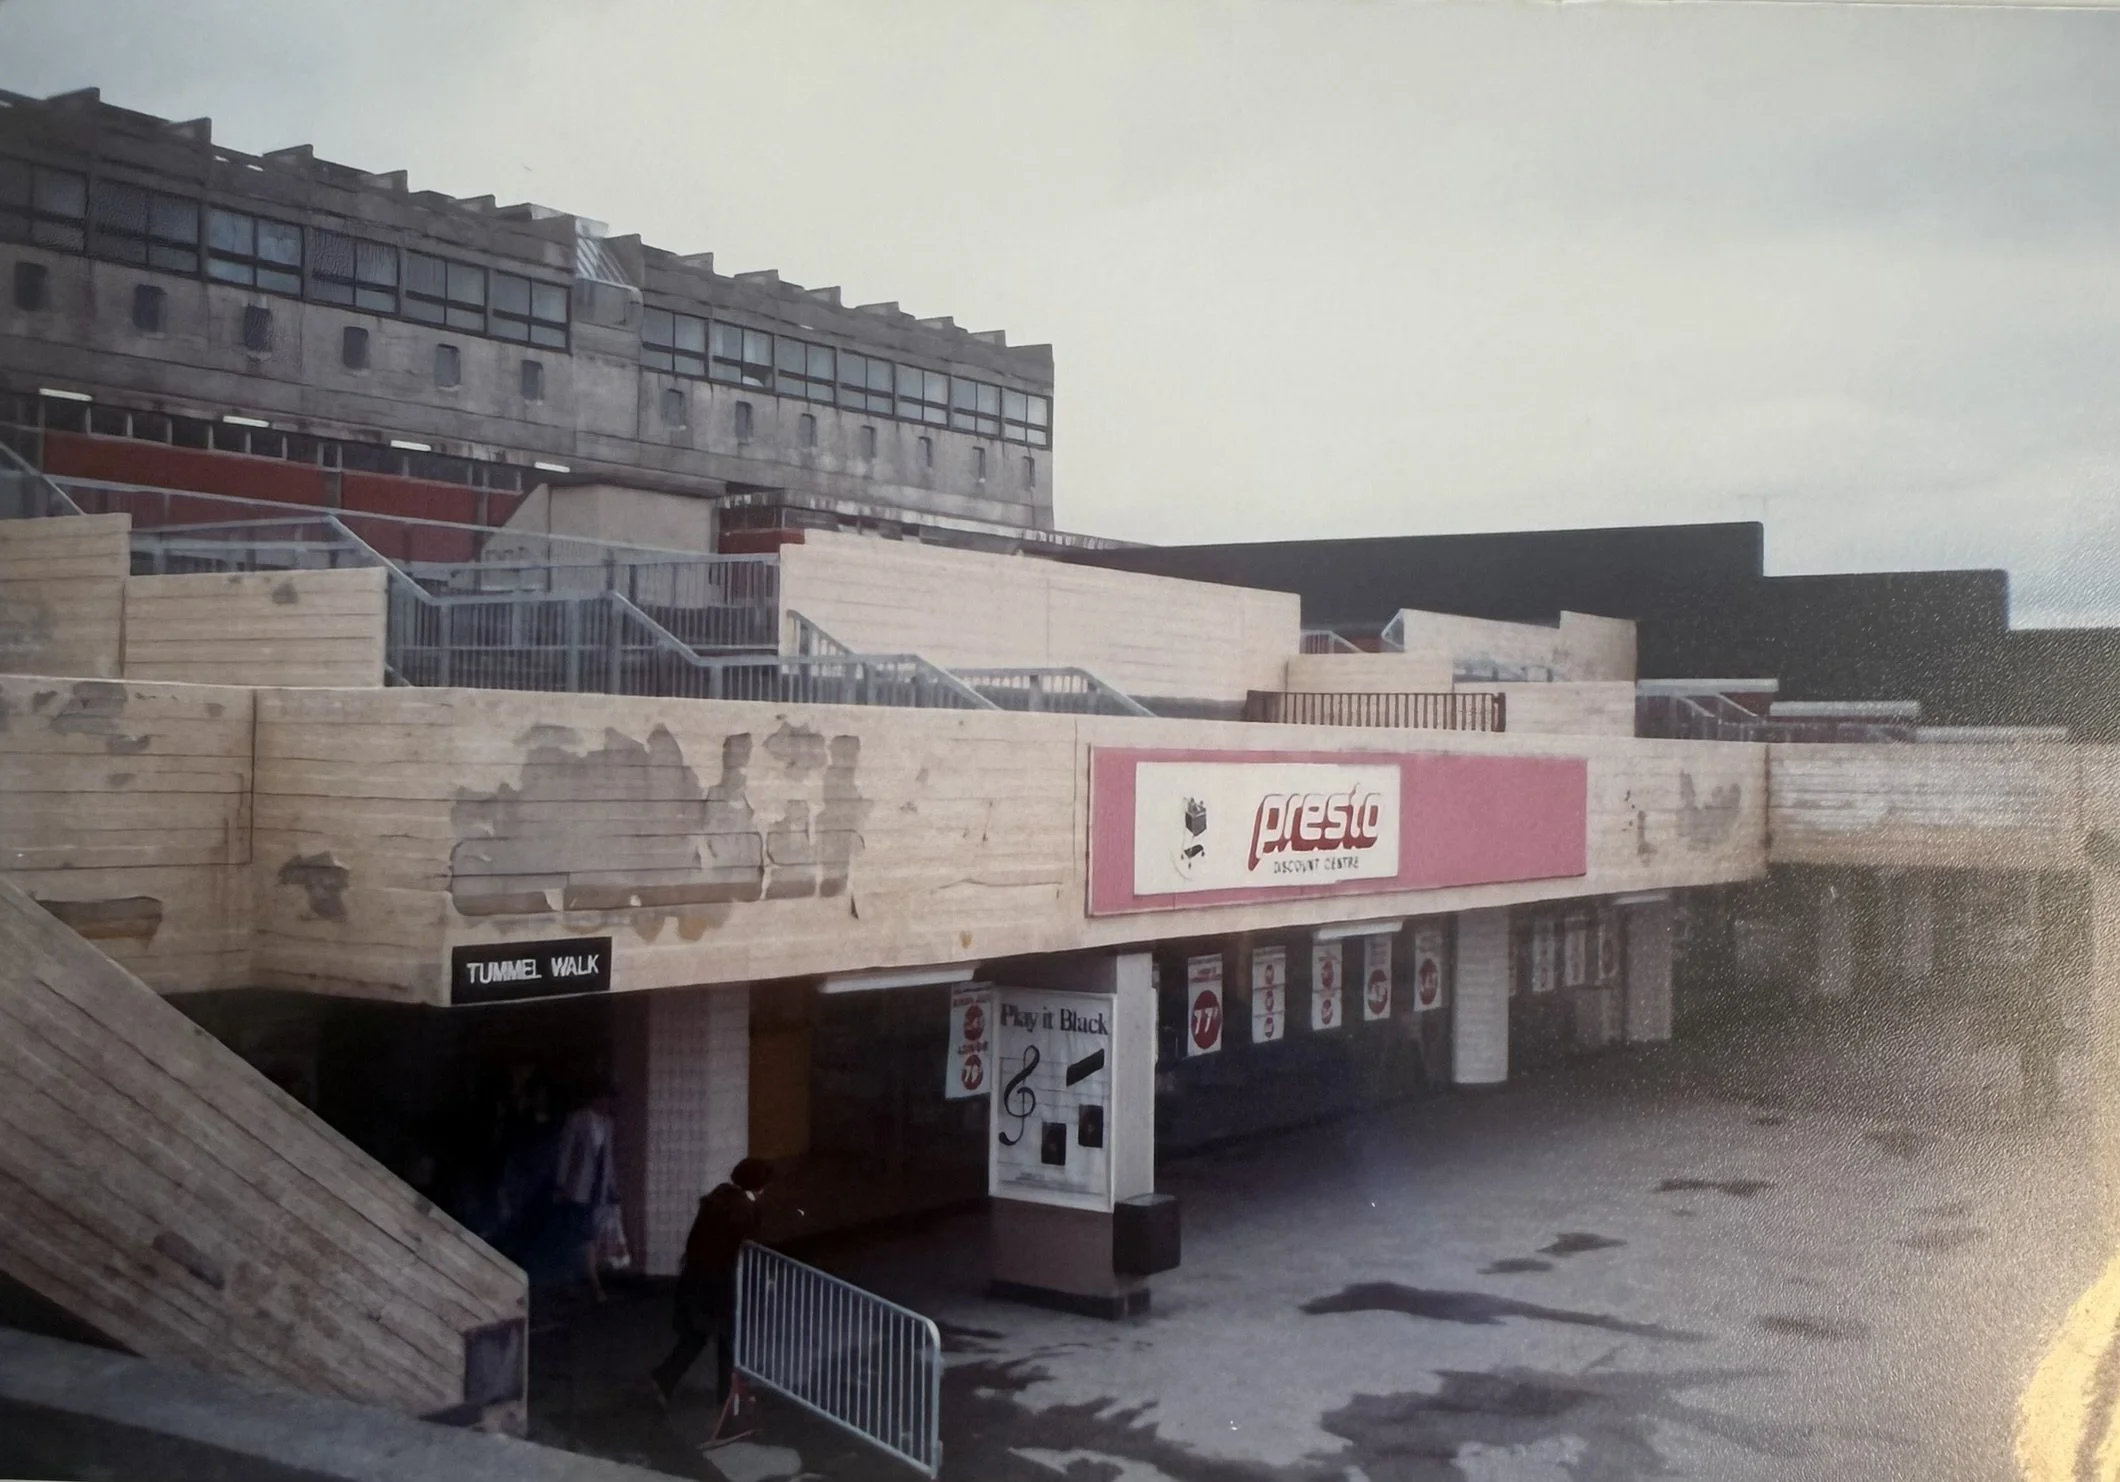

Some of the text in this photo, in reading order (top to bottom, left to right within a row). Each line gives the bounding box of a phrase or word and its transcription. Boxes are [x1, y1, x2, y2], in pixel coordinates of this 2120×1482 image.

[1248, 782, 1381, 872] presto
[1273, 856, 1359, 874] DISCOUNT CENTRE
[466, 954, 600, 984] TUMMEL WALK
[1000, 1003, 1038, 1033] Play
[1042, 1006, 1054, 1029] it
[1060, 1008, 1109, 1035] Black
